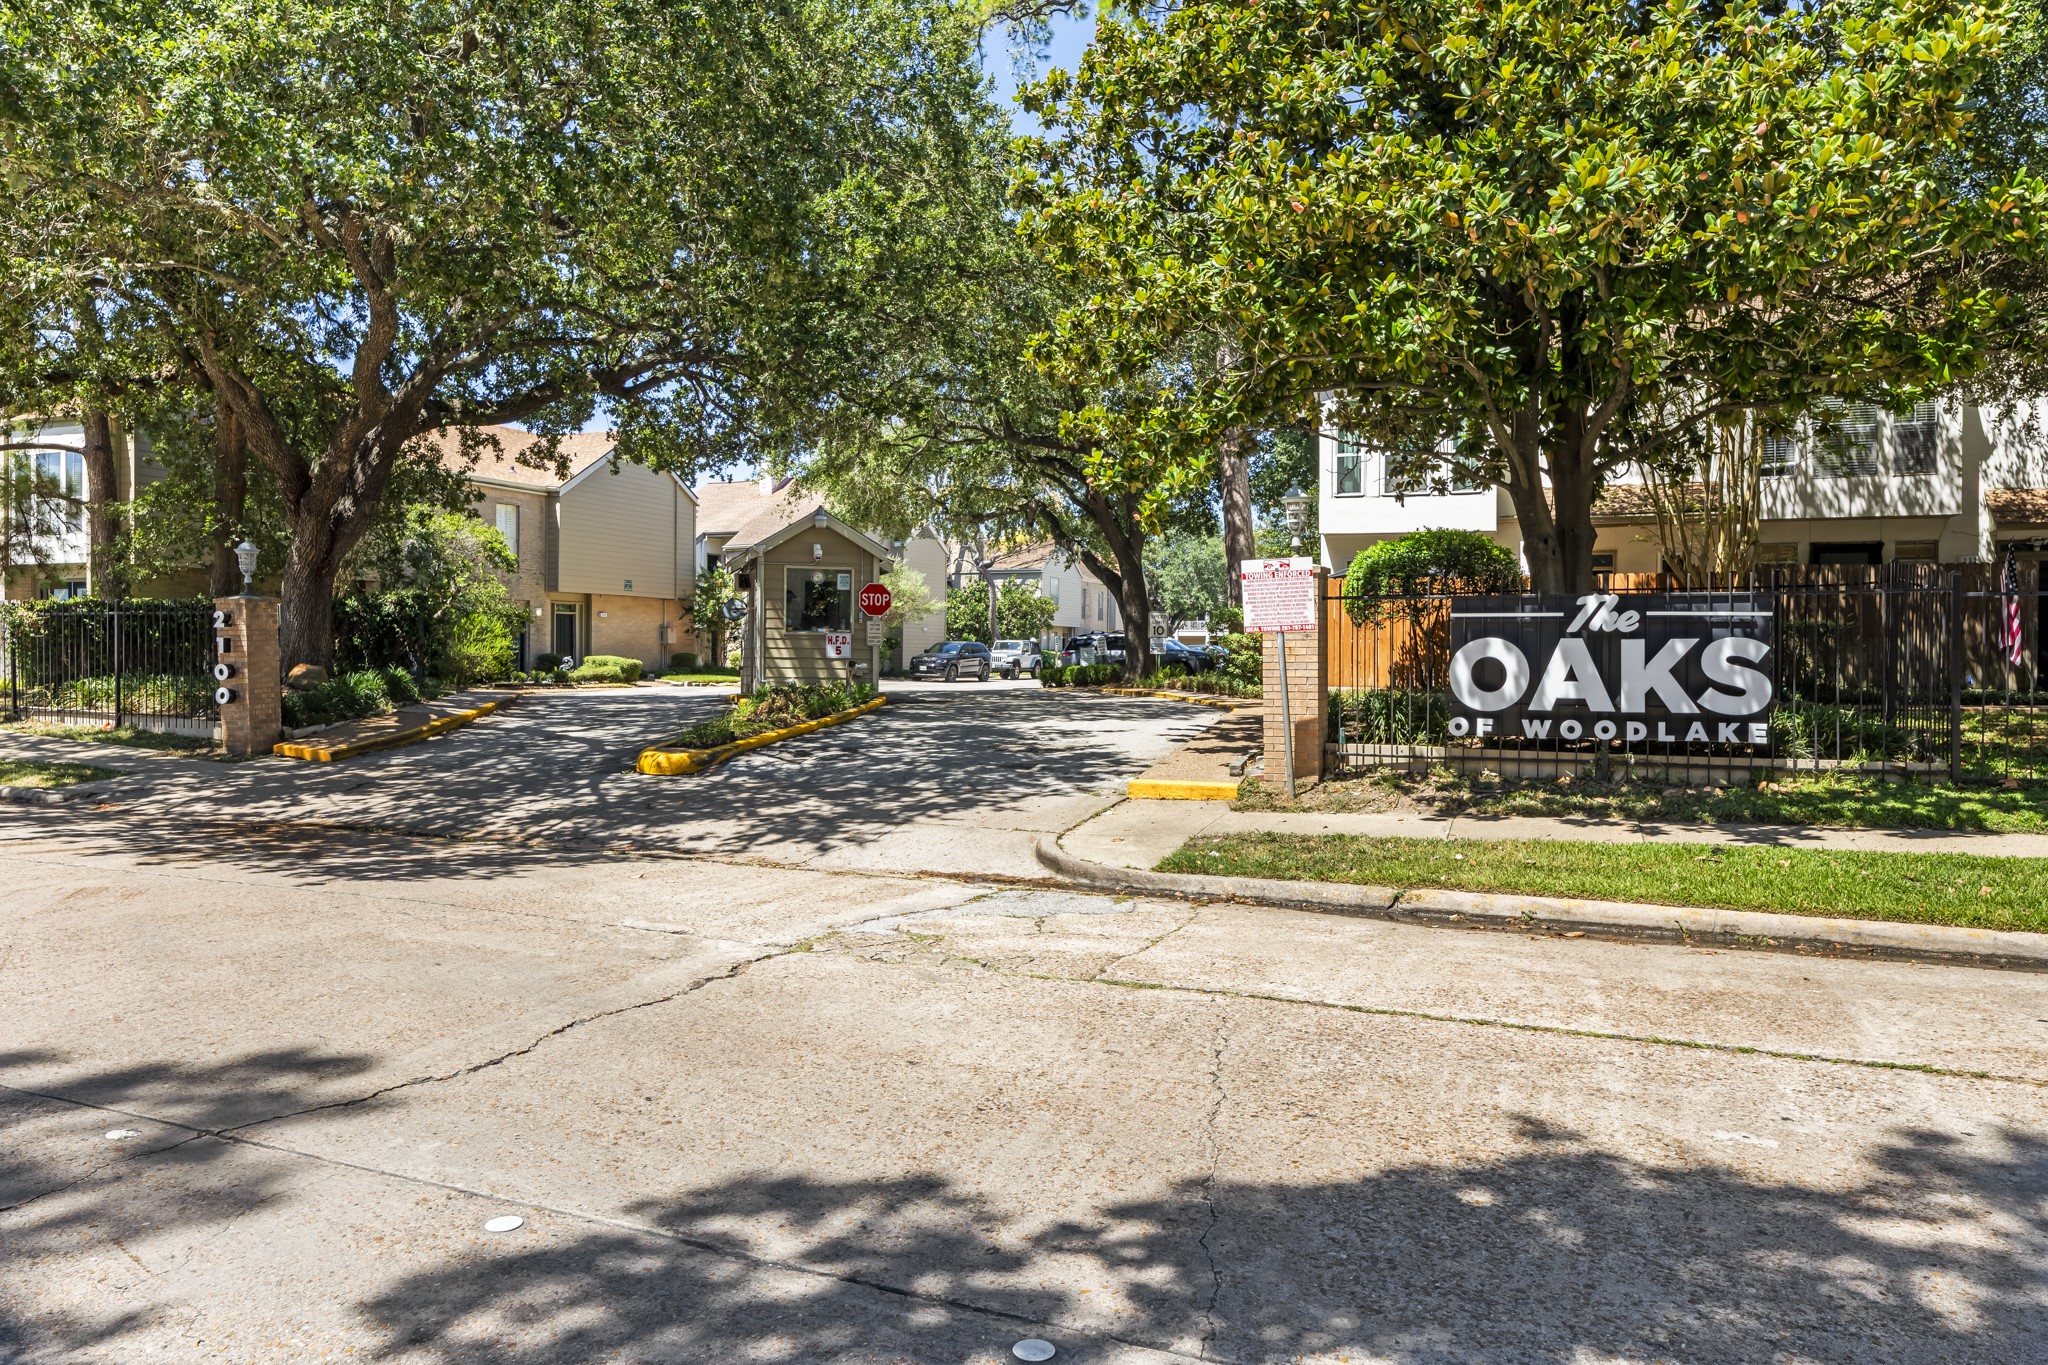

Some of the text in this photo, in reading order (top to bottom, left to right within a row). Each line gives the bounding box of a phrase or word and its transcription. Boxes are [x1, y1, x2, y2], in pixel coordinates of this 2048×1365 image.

[1244, 570, 1311, 580] TOWING ENFORCED
[861, 593, 890, 606] STOP
[1566, 593, 1641, 633] The
[1153, 625, 1165, 636] 10
[827, 635, 850, 645] H.F.D.
[835, 646, 842, 656] 5
[1449, 637, 1773, 716] OAKS
[1447, 717, 1769, 745] OF WOODLAKE
